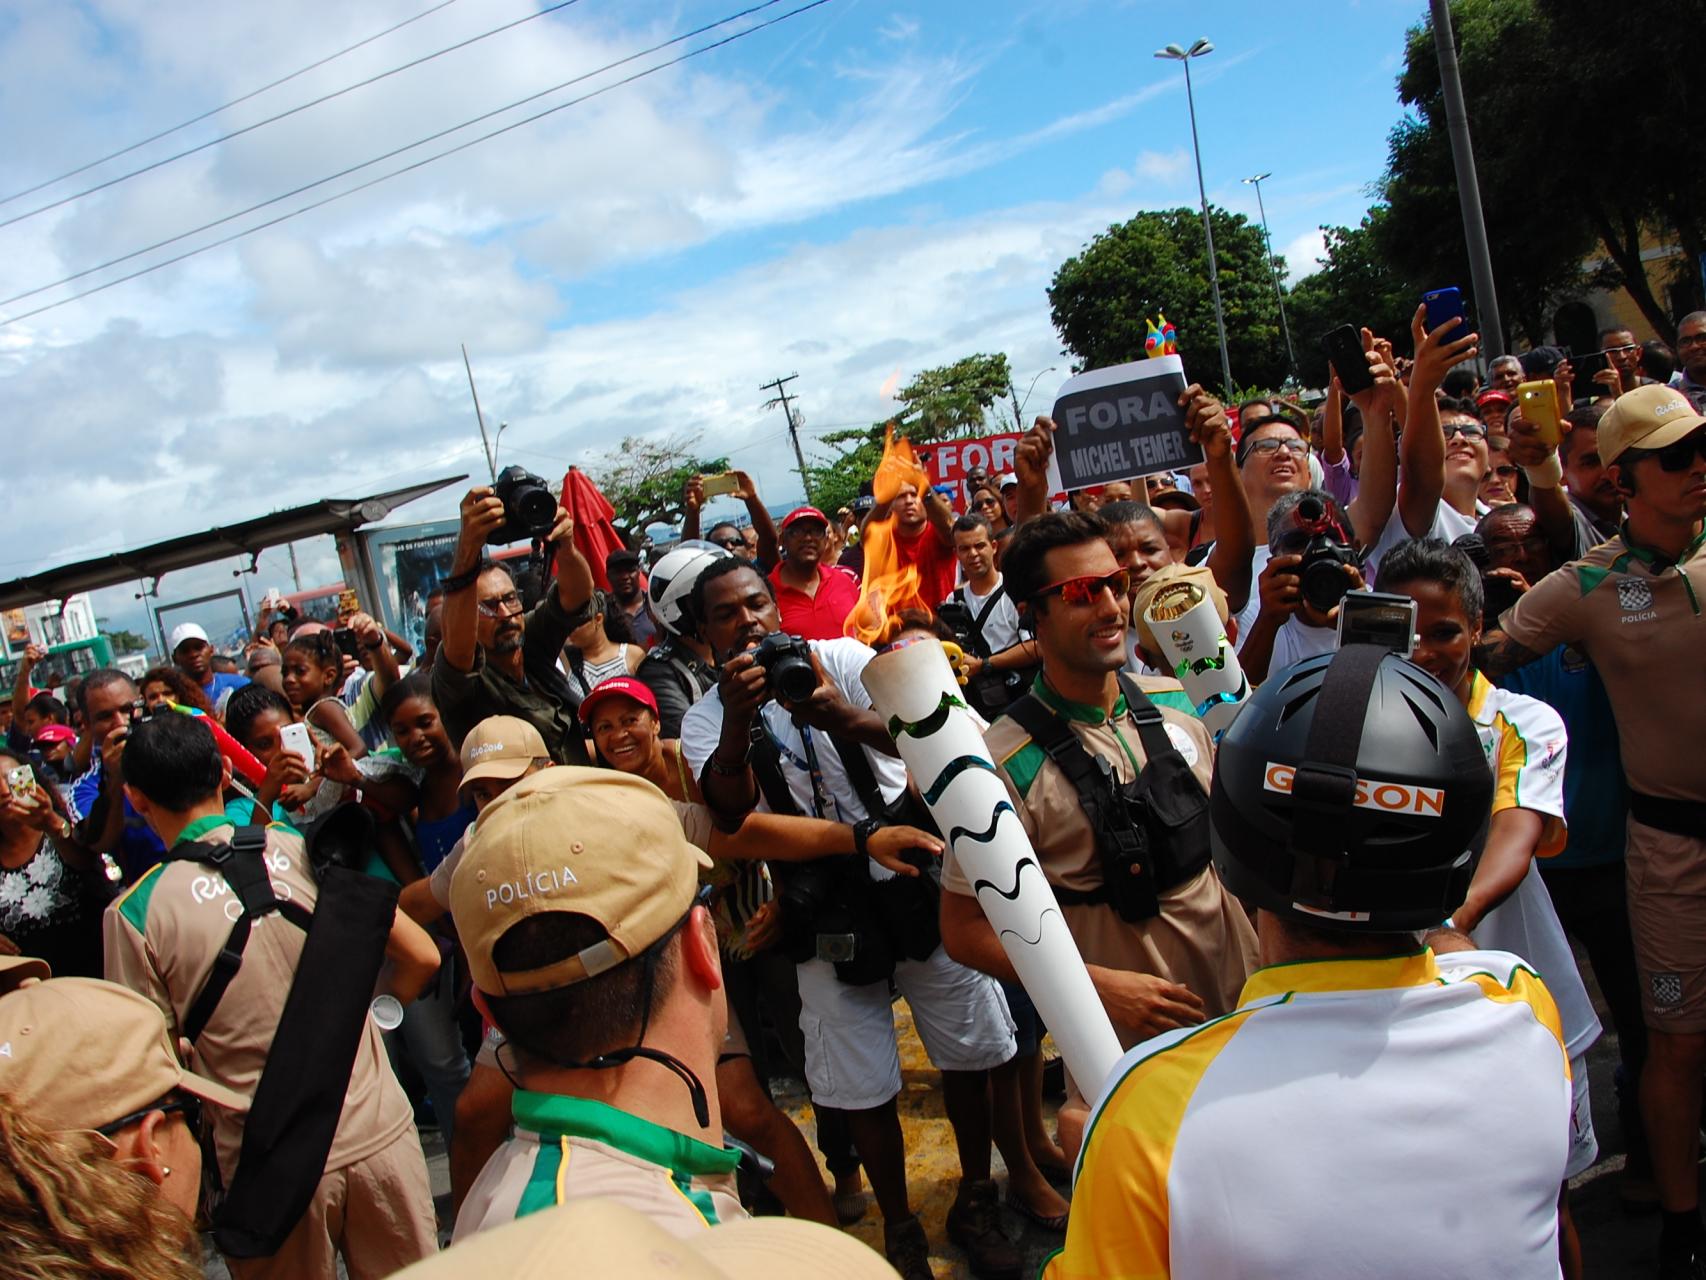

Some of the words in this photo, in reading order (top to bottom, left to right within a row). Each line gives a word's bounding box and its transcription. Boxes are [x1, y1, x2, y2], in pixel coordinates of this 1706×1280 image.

[1066, 391, 1176, 435] FORA
[937, 438, 1018, 478] FOR
[1070, 441, 1131, 479] MICHEL
[1130, 431, 1186, 467] TEMER
[1621, 611, 1657, 624] POLÍCIA
[1266, 765, 1444, 815] GSON
[486, 865, 579, 910] POLÍCIA
